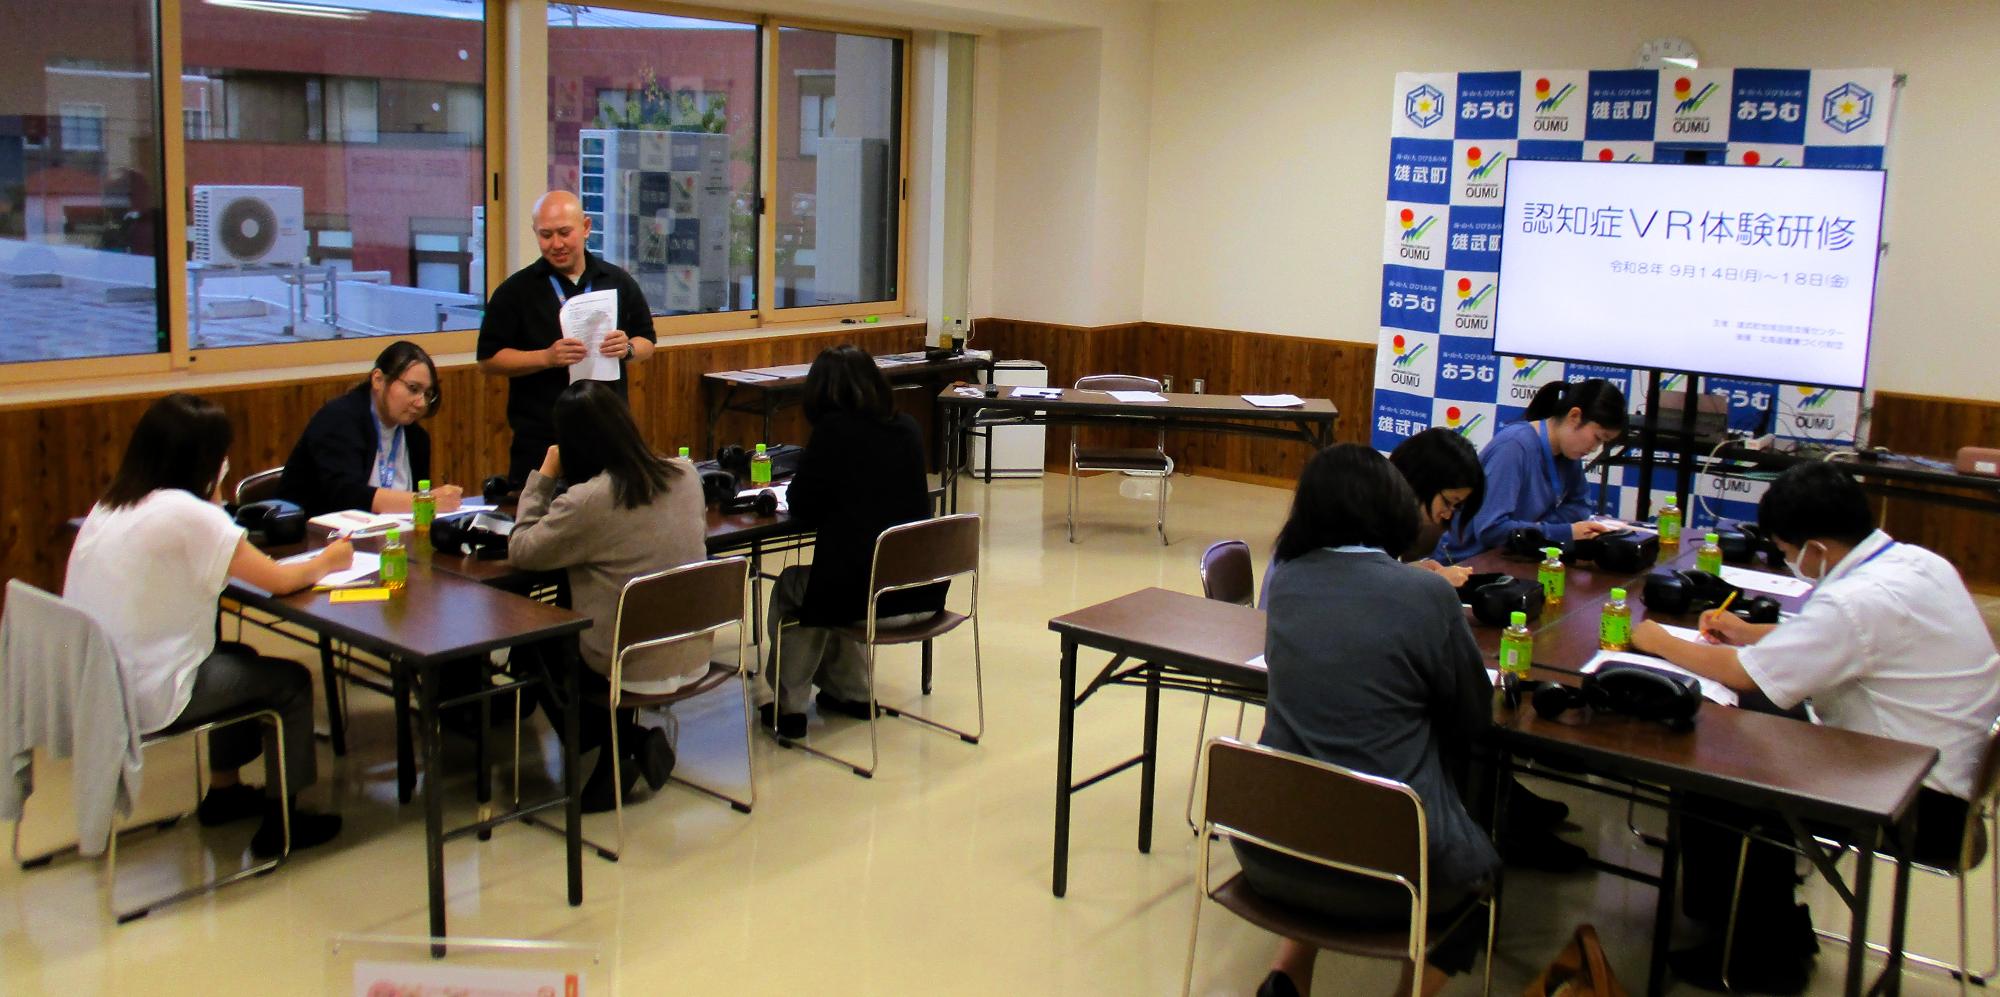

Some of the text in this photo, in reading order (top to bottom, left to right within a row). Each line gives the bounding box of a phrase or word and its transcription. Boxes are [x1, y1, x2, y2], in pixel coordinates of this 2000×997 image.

[1461, 101, 1514, 119] おうむ
[1592, 100, 1652, 120] 雄武町
[1737, 100, 1801, 123] おうむ
[1533, 120, 1569, 132] OUMU
[1672, 120, 1710, 133] OUMU
[1394, 164, 1448, 184] 雄武町
[1465, 186, 1498, 198] OUMU
[1522, 201, 1857, 251] 認知症VR体験研修
[1400, 247, 1430, 261] OUMU
[1610, 259, 1664, 275] 令和8年
[1388, 291, 1436, 313] おうむ
[1455, 317, 1488, 330] OUMU
[1391, 372, 1420, 387] OUMU
[1441, 362, 1495, 382] おうむ
[1510, 387, 1540, 400] OUM
[1795, 415, 1835, 430] OUMU
[1712, 478, 1751, 493] OUMU
